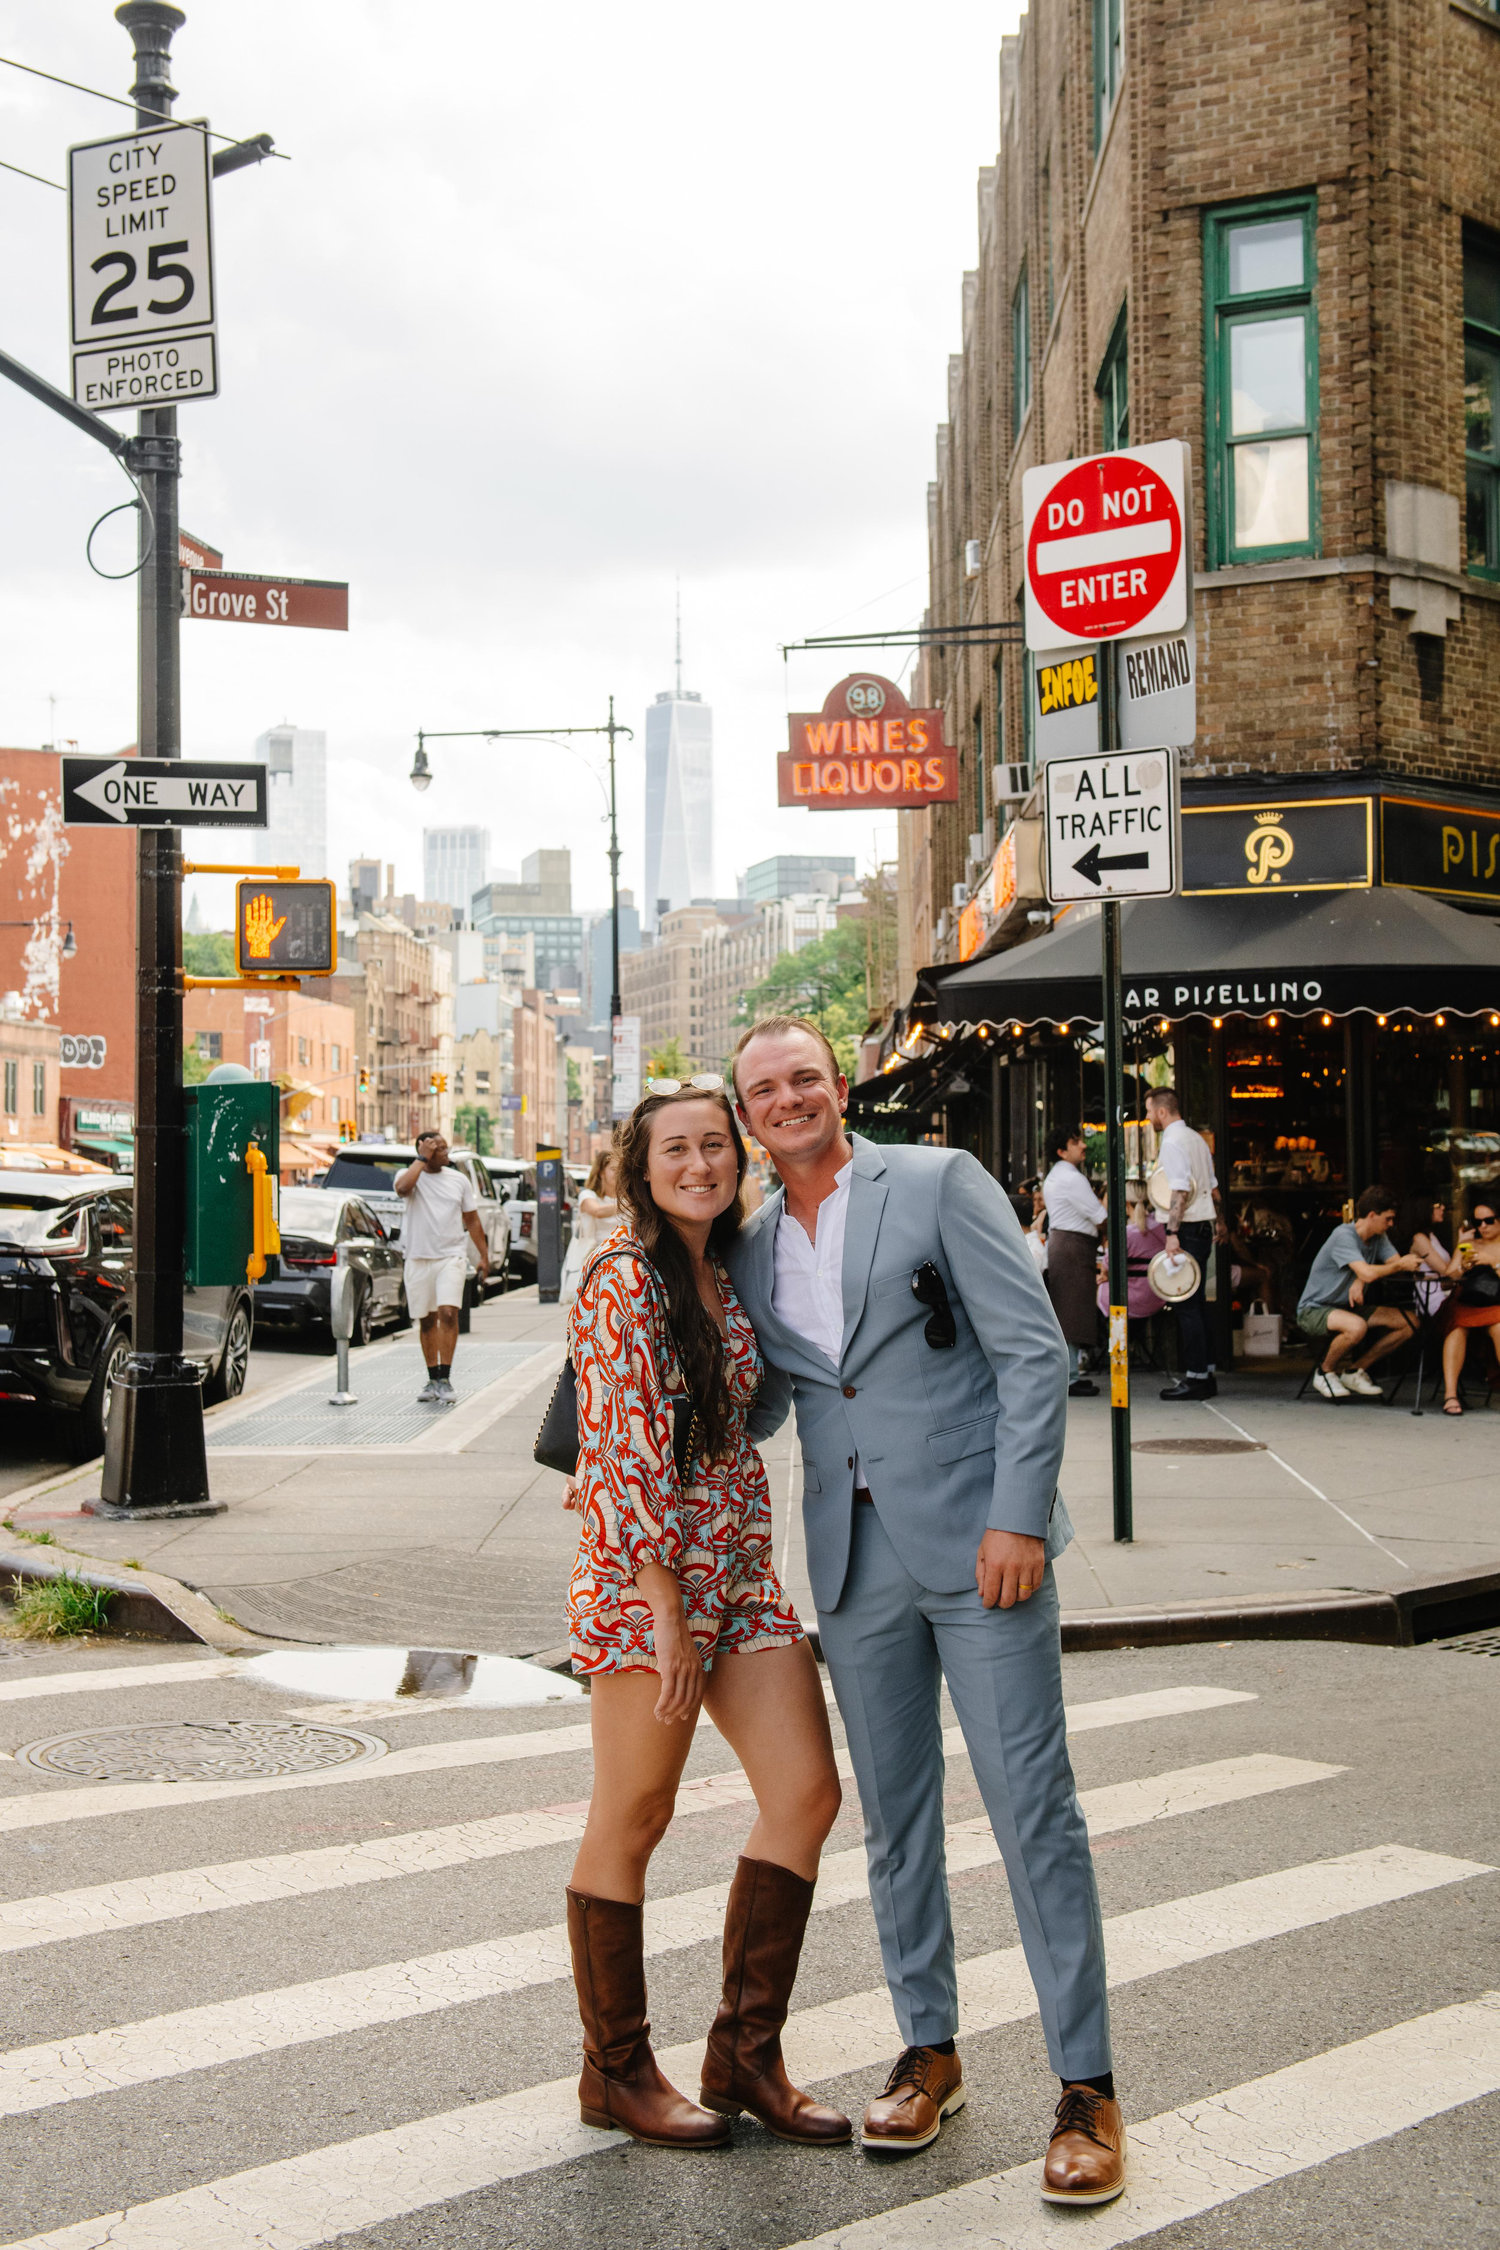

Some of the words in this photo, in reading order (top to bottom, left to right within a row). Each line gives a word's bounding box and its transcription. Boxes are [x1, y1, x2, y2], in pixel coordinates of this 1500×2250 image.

[109, 143, 163, 174] CITY
[97, 174, 177, 208] SPEED
[106, 207, 170, 238] LIMIT
[90, 240, 195, 326] 25
[108, 349, 180, 376] PHOTO
[86, 369, 204, 402] ENFORCED
[1047, 498, 1085, 531] DO
[1102, 483, 1156, 520] NOT
[193, 582, 257, 619] Grove
[265, 588, 289, 621] St
[1060, 568, 1148, 608] ENTER
[1126, 638, 1192, 700] REMAND
[852, 687, 880, 709] 98
[804, 718, 929, 755] WINES
[104, 779, 158, 806] ONE
[188, 782, 246, 807] WAY
[793, 758, 945, 796] LIQUORS
[1075, 765, 1141, 802] ALL
[1056, 805, 1163, 840] TRAFFIC
[1125, 987, 1160, 1008] AR
[1174, 981, 1322, 1006] PISELLINO
